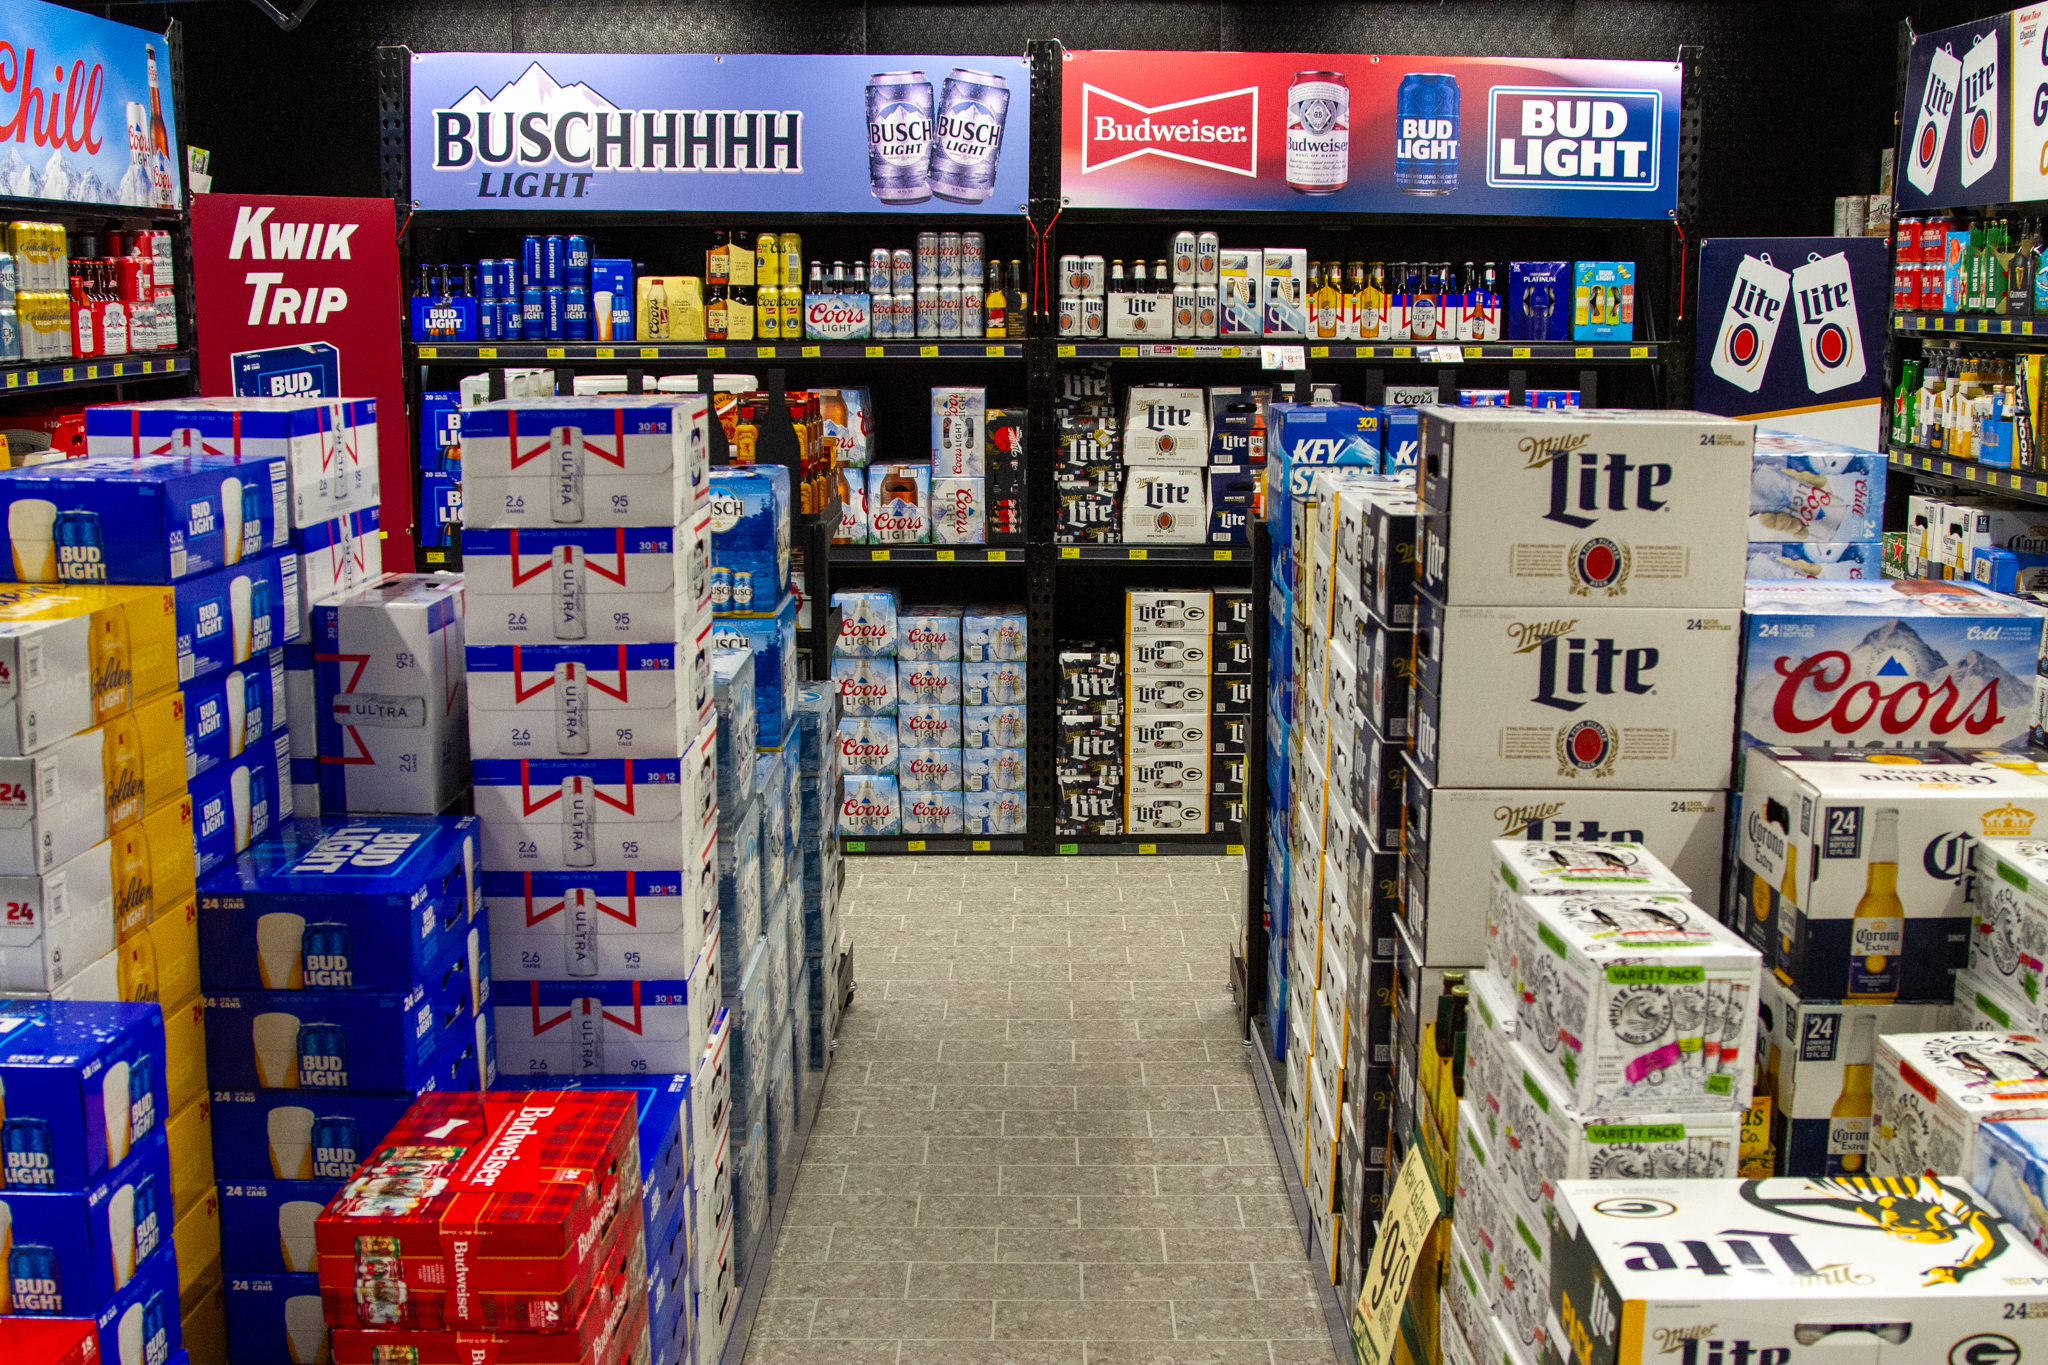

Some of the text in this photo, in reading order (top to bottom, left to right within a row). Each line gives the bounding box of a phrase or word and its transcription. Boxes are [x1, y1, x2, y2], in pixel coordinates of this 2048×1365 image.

[1924, 73, 1953, 117] Lite
[1964, 62, 1995, 114] Lite
[1522, 100, 1628, 138] BUD
[870, 120, 933, 146] BUSCH
[938, 114, 1001, 146] BUSCH
[1094, 116, 1247, 143] Budweiser
[1403, 119, 1452, 139] BUD
[434, 110, 801, 169] BUSCHHHHH
[1287, 136, 1348, 152] Budweiser
[1397, 139, 1458, 160] LIGHT
[1500, 138, 1647, 177] LIGHT
[477, 172, 593, 198] LIGHT
[229, 206, 359, 260] KWIK
[245, 272, 348, 325] TRIP
[1731, 277, 1781, 323] Lite
[1798, 282, 1850, 325] Lite
[430, 309, 457, 319] BUD
[809, 303, 865, 324] Coors
[425, 318, 462, 329] LIGHT
[1146, 404, 1191, 432] Lite
[2019, 416, 2028, 465] MOON
[1292, 438, 1345, 464] KEY
[1517, 433, 1592, 469] Miller
[953, 447, 962, 474] Coors
[561, 450, 572, 506] ULTRA
[917, 467, 926, 475] 18
[1135, 476, 1160, 489] Miller
[1541, 450, 1673, 529] Lite
[505, 495, 524, 507] 2.6
[611, 495, 629, 507] 95
[1145, 482, 1190, 509] Lite
[1852, 480, 1869, 518] Chill
[874, 513, 923, 530] Coors
[1979, 517, 1988, 525] 12
[60, 546, 101, 563] BUD
[58, 562, 107, 580] LIGHT
[562, 569, 575, 623] ULTRA
[508, 613, 527, 625] 2.6
[613, 613, 630, 624] 95
[1687, 619, 1702, 630] 24
[1507, 619, 1579, 654] Miller
[1759, 624, 1779, 637] 24
[1966, 625, 2002, 641] Cold
[640, 659, 669, 667] 30 12
[91, 657, 132, 700] Golden
[1530, 635, 1660, 712] Lite
[1773, 650, 2006, 735] Coors
[356, 704, 408, 718] ULTRA
[566, 686, 579, 739] ULTRA
[909, 715, 948, 730] Coors
[511, 729, 531, 740] 2.6
[616, 729, 633, 740] 95
[910, 758, 949, 774] Coors
[648, 773, 676, 781] 30 12
[106, 768, 144, 814] Golden
[843, 799, 890, 817] Coors
[912, 802, 950, 816] Coors
[1671, 802, 1686, 812] 24
[572, 800, 584, 851] ULTRA
[1493, 802, 1566, 837] Miller
[1830, 811, 1857, 835] 24
[1749, 810, 1784, 860] Corona
[518, 841, 537, 853] 2.6
[622, 841, 639, 853] 95
[1754, 853, 1774, 874] Extra
[649, 885, 677, 893] 30 12
[115, 876, 153, 922] Golden
[7, 902, 34, 920] 24
[575, 911, 587, 962] ULTRA
[1856, 927, 1899, 945] Corona
[1865, 943, 1890, 953] Extra
[307, 955, 348, 970] BUD
[521, 952, 540, 963] 2.6
[624, 952, 641, 963] 95
[1612, 969, 1701, 981] VARIETY PACK
[219, 1001, 241, 1009] CANS
[655, 995, 682, 1003] 30 12
[1609, 983, 1666, 1030] WHITE CLAW
[1808, 1017, 1834, 1039] 24
[582, 1020, 594, 1069] ULTRA
[1922, 1035, 2026, 1065] WHITE CLAW
[83, 1066, 91, 1080] 18
[529, 1059, 547, 1071] 2.6
[631, 1059, 647, 1071] 95
[235, 1095, 256, 1103] CANS
[1593, 1127, 1681, 1140] VARIETY PACK
[1833, 1129, 1869, 1144] Coron
[471, 1105, 555, 1187] Budweiser
[1841, 1142, 1865, 1151] Extra
[8, 1152, 49, 1168] BUD
[317, 1148, 356, 1163] BUD
[5, 1168, 56, 1185] LIGHT
[577, 1180, 618, 1263] Budweiser
[15, 1279, 57, 1294] BUD
[252, 1284, 273, 1292] CANS
[453, 1240, 469, 1320] Budweiser
[13, 1294, 62, 1311] LIGHT
[2003, 1303, 2027, 1319] 24
[592, 1282, 628, 1364] Budweiser
[1653, 1324, 1718, 1355] Miller
